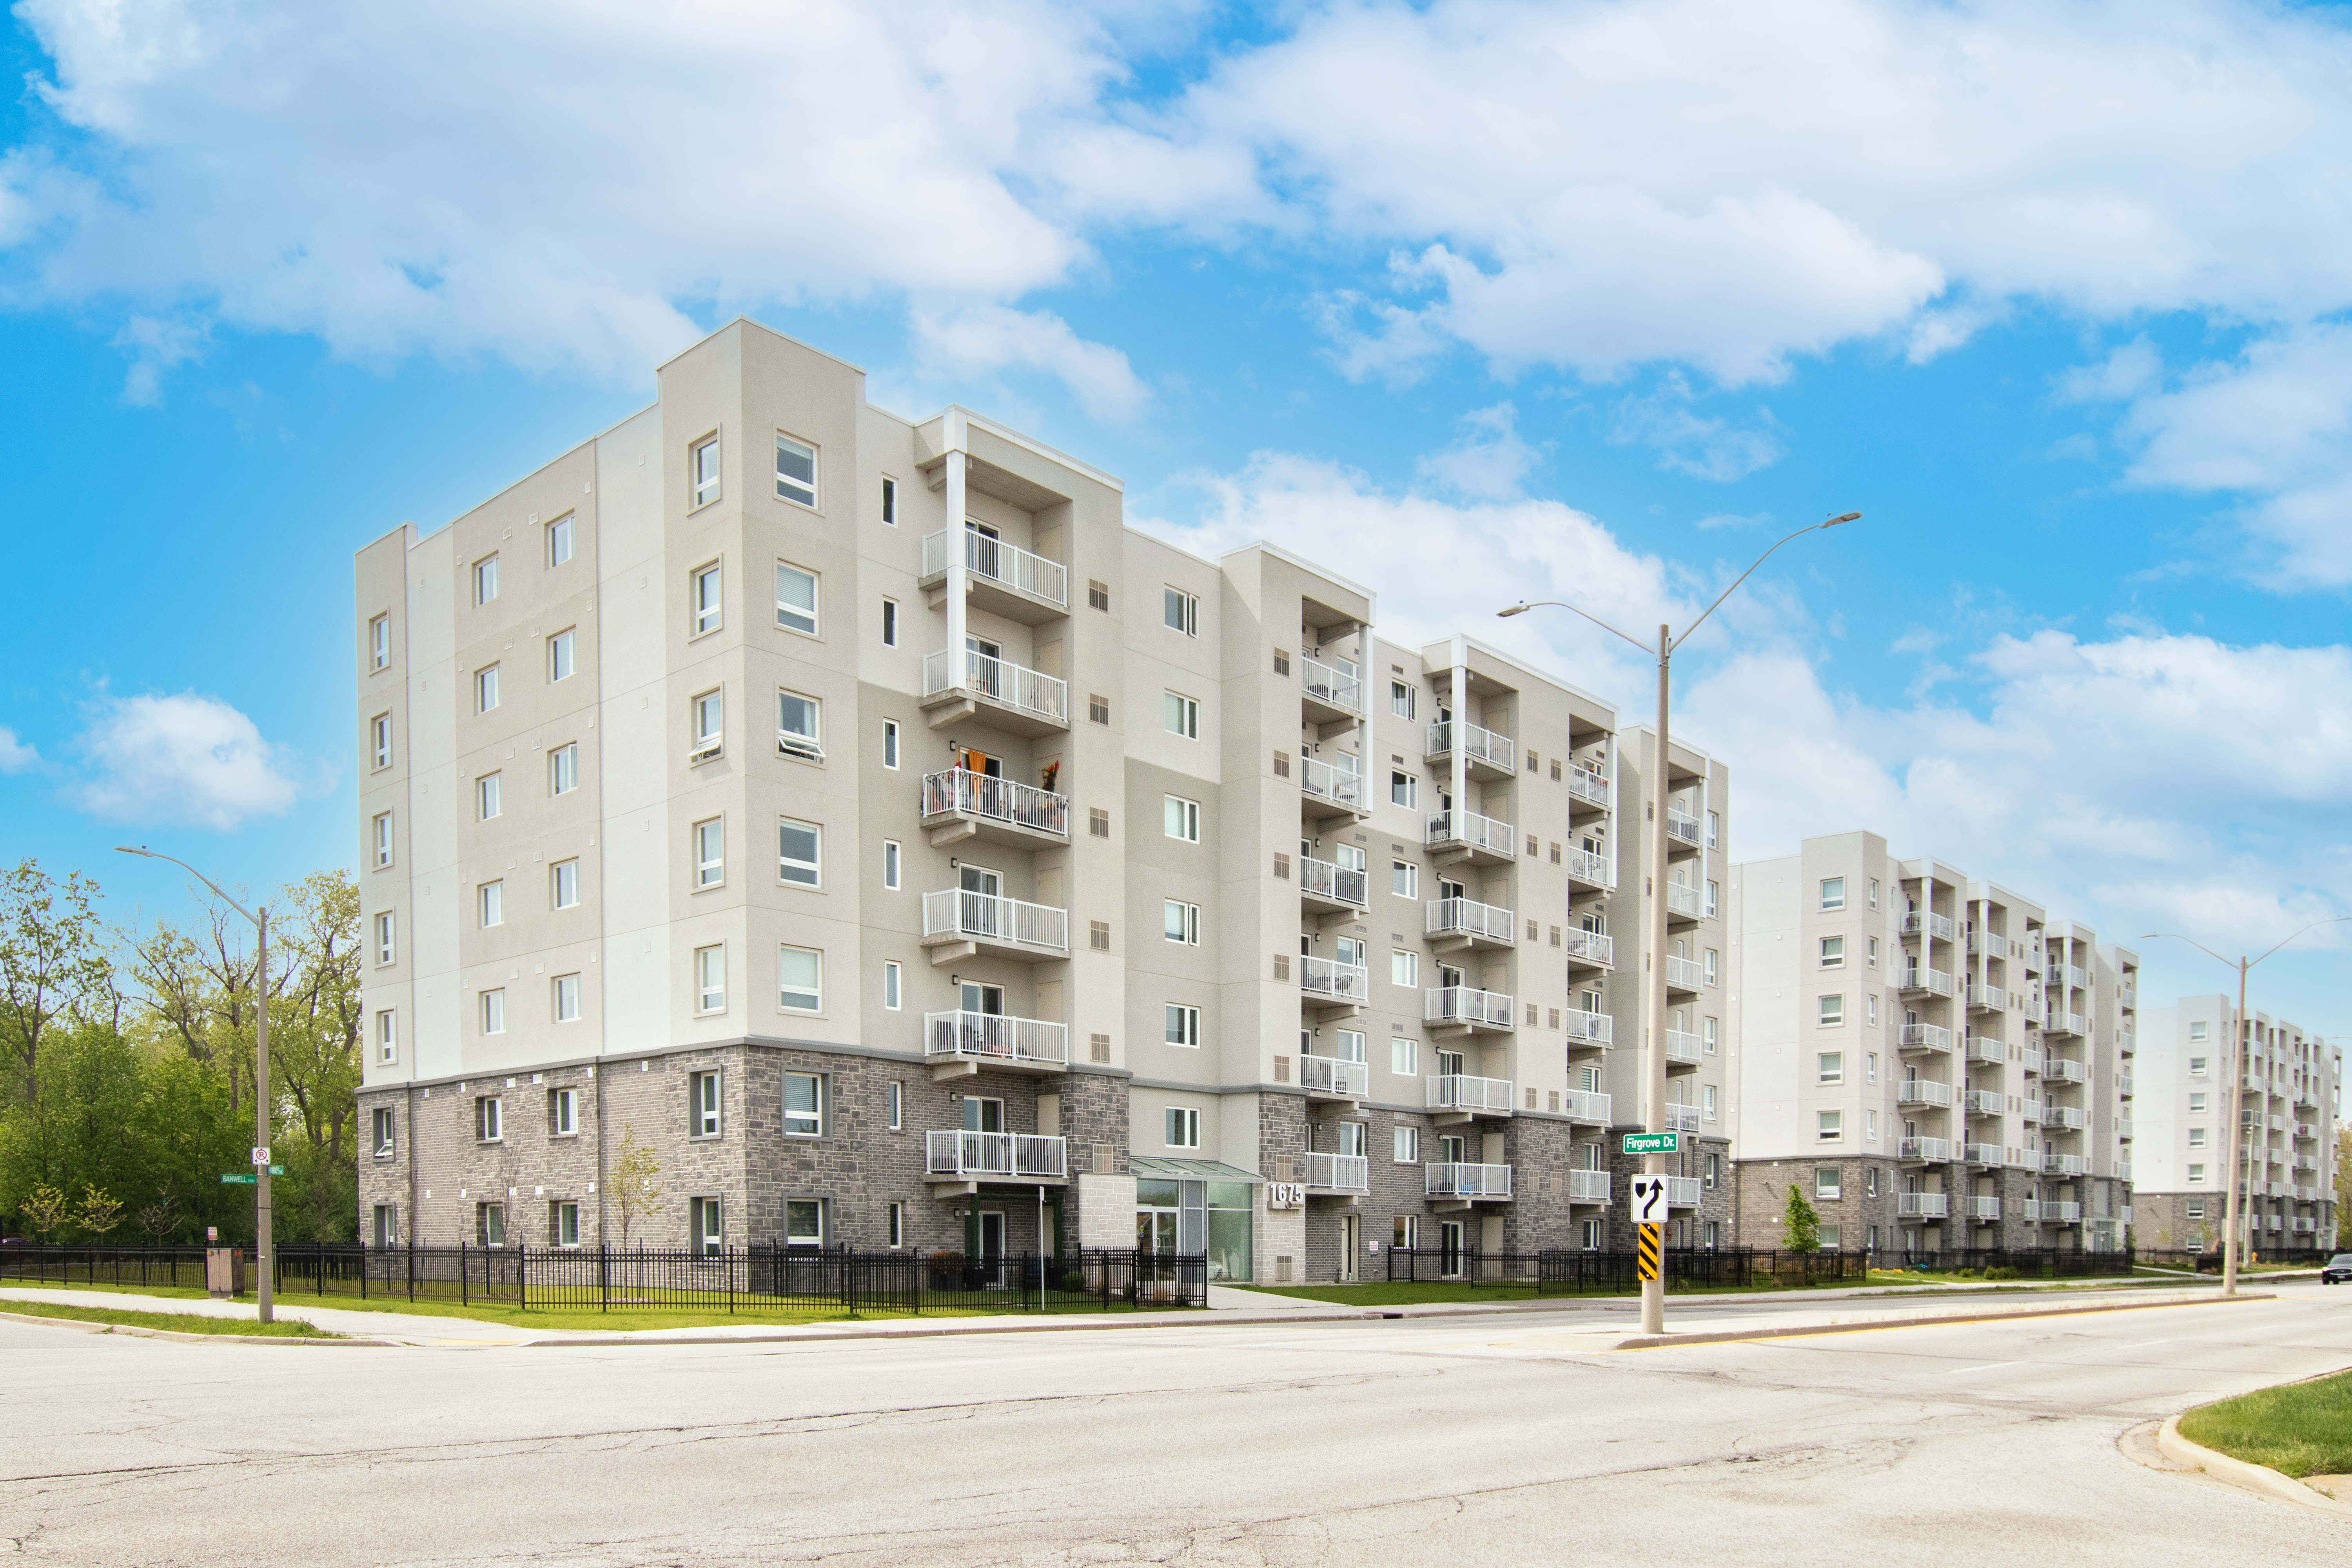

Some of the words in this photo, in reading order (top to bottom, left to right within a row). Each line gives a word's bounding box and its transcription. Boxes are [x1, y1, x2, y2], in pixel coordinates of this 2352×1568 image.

[1627, 1138, 1660, 1150] Firgrove
[1663, 1136, 1675, 1147] Dr.
[1270, 1183, 1303, 1202] 1675
